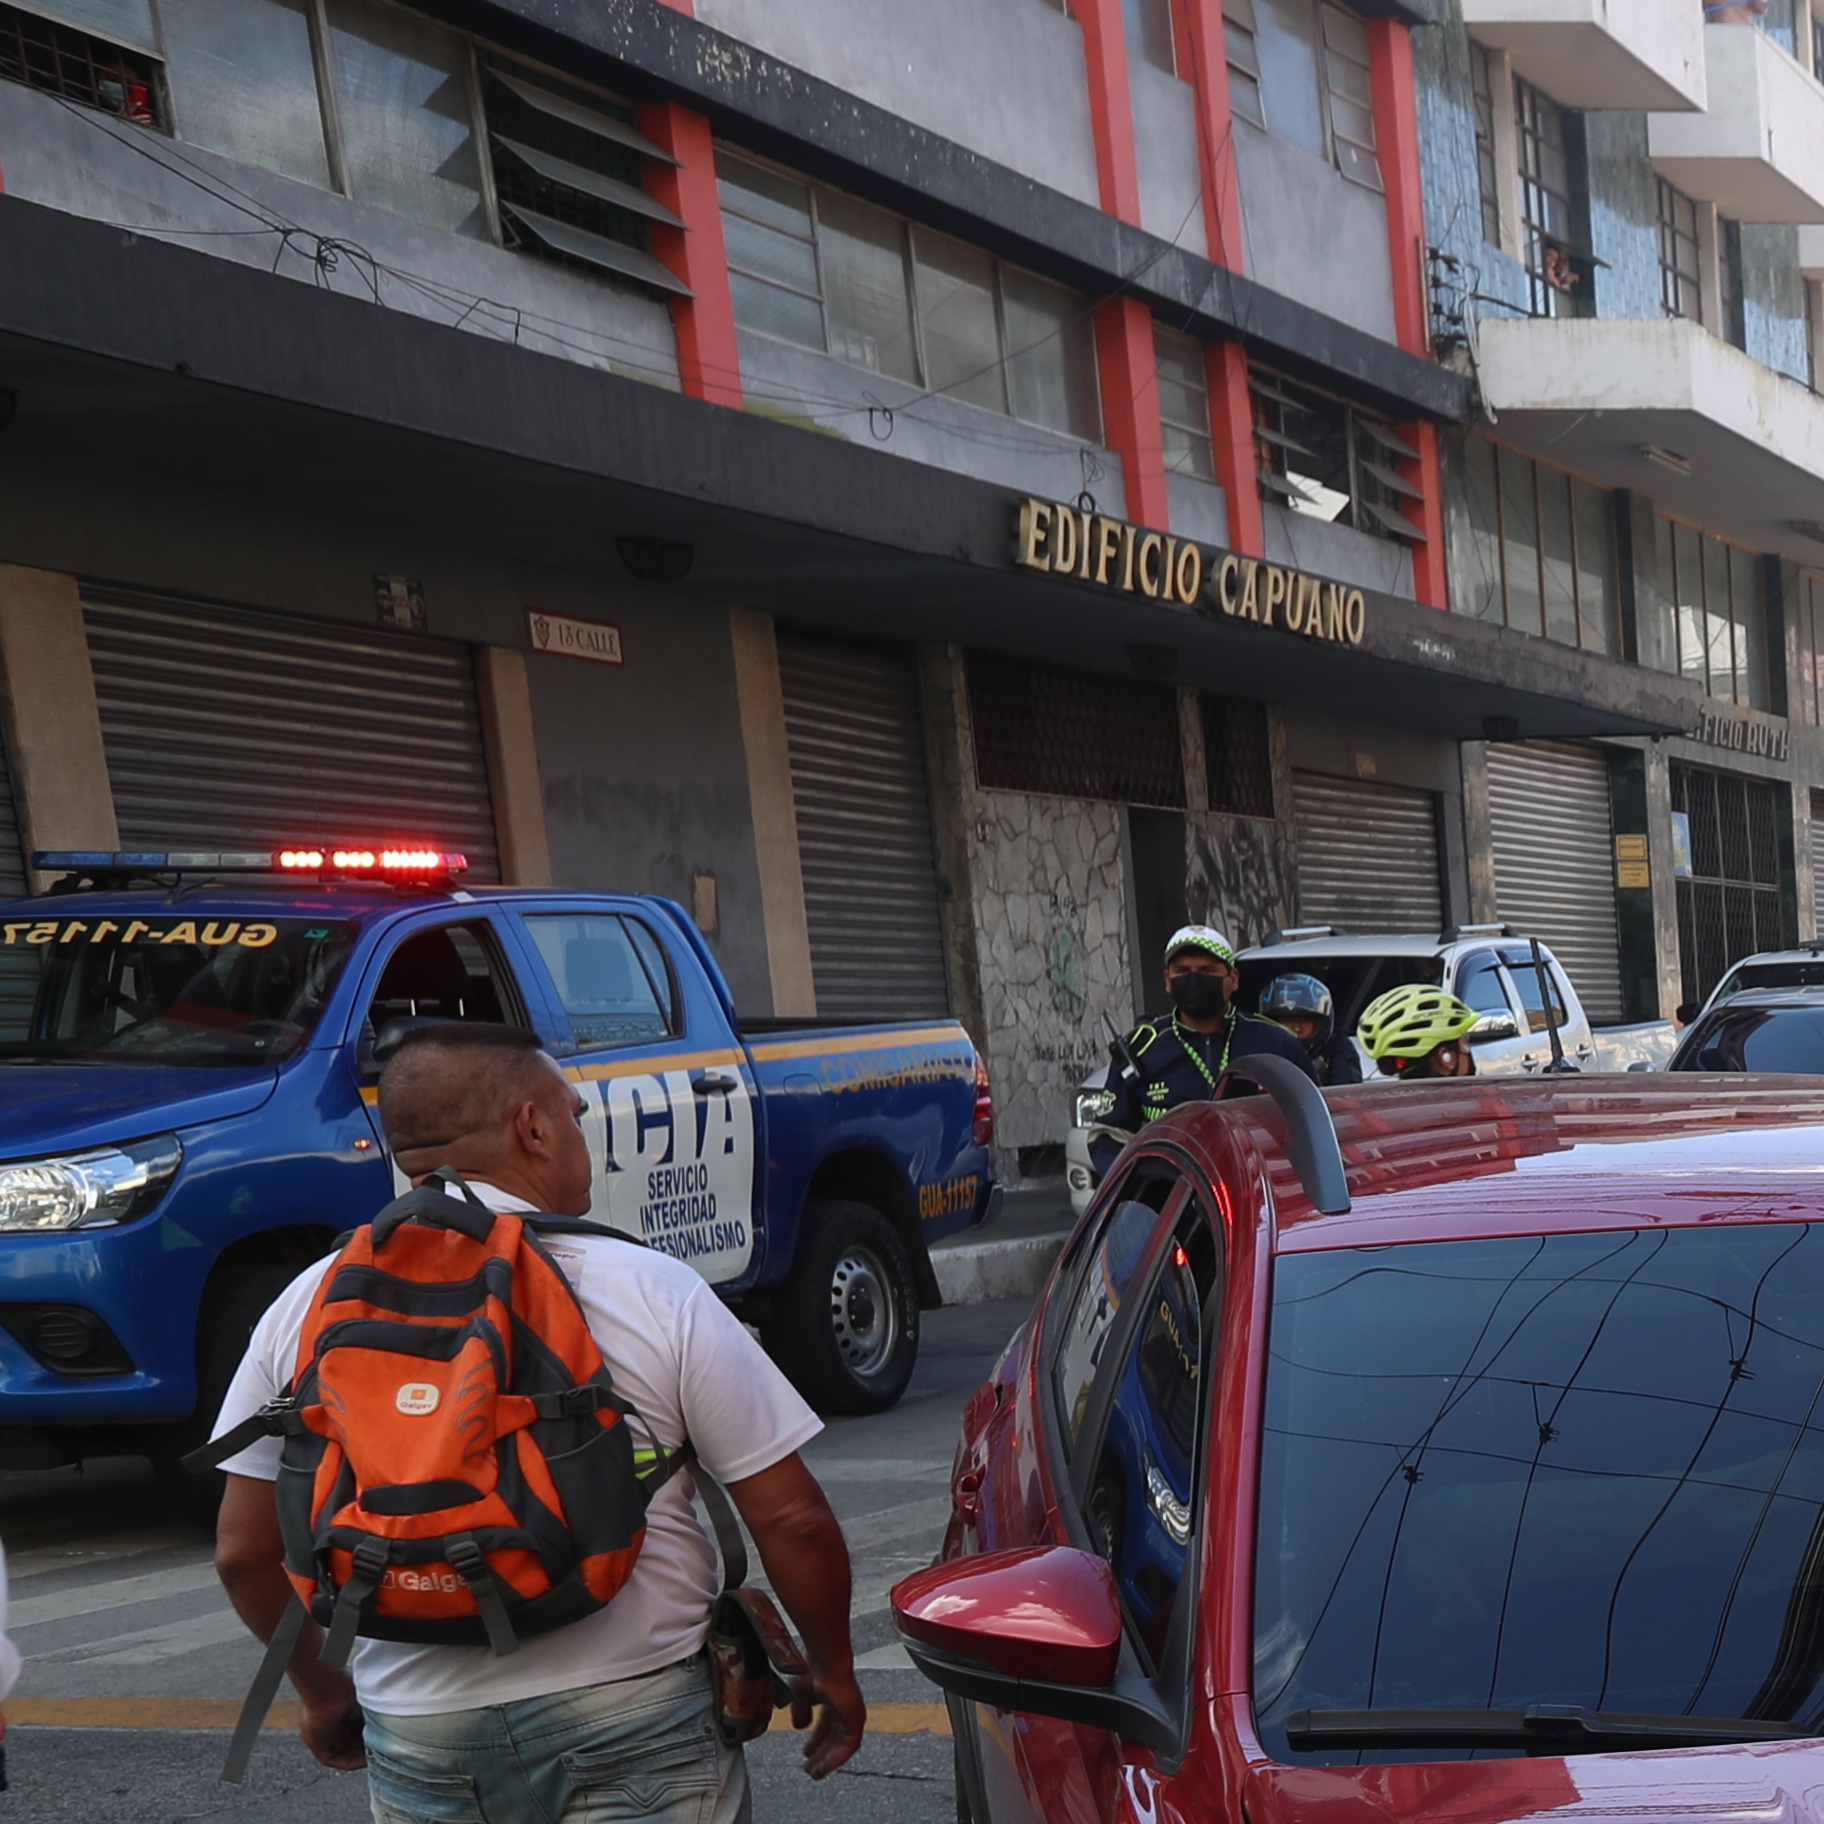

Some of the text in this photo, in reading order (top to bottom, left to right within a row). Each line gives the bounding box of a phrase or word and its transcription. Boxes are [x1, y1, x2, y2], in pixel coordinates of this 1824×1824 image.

[1017, 498, 1366, 645] EDIFICIO CAPUANO
[557, 624, 618, 656] 13 CALLE
[1748, 720, 1790, 760] RUTH
[647, 1162, 709, 1201] SERVICIO
[918, 1175, 979, 1220] GUA-11157
[639, 1192, 717, 1235] INTEGRIDAD
